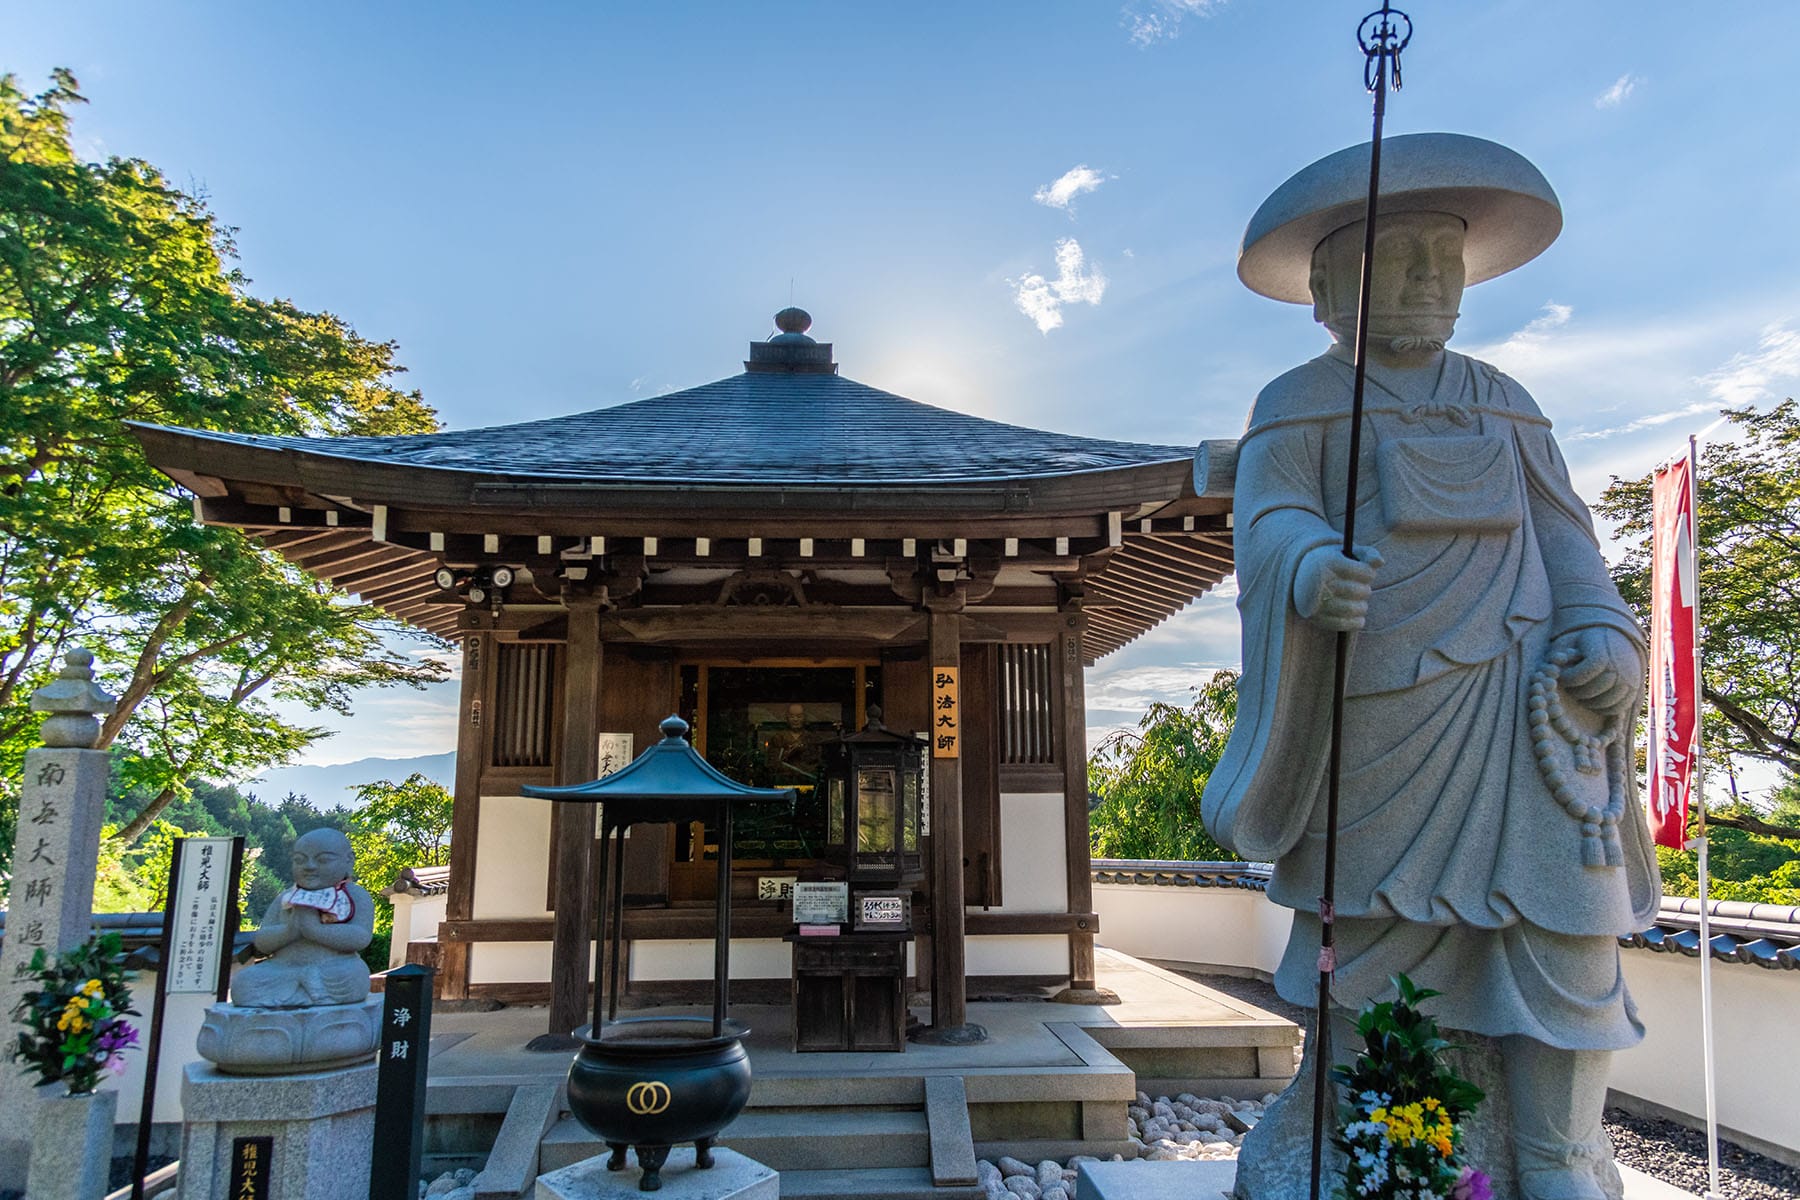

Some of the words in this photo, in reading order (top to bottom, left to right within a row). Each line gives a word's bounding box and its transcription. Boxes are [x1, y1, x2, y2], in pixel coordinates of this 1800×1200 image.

[936, 673, 956, 750] 弘法大師
[391, 1008, 411, 1059] 浄財
[239, 1143, 258, 1200] 稚児大
